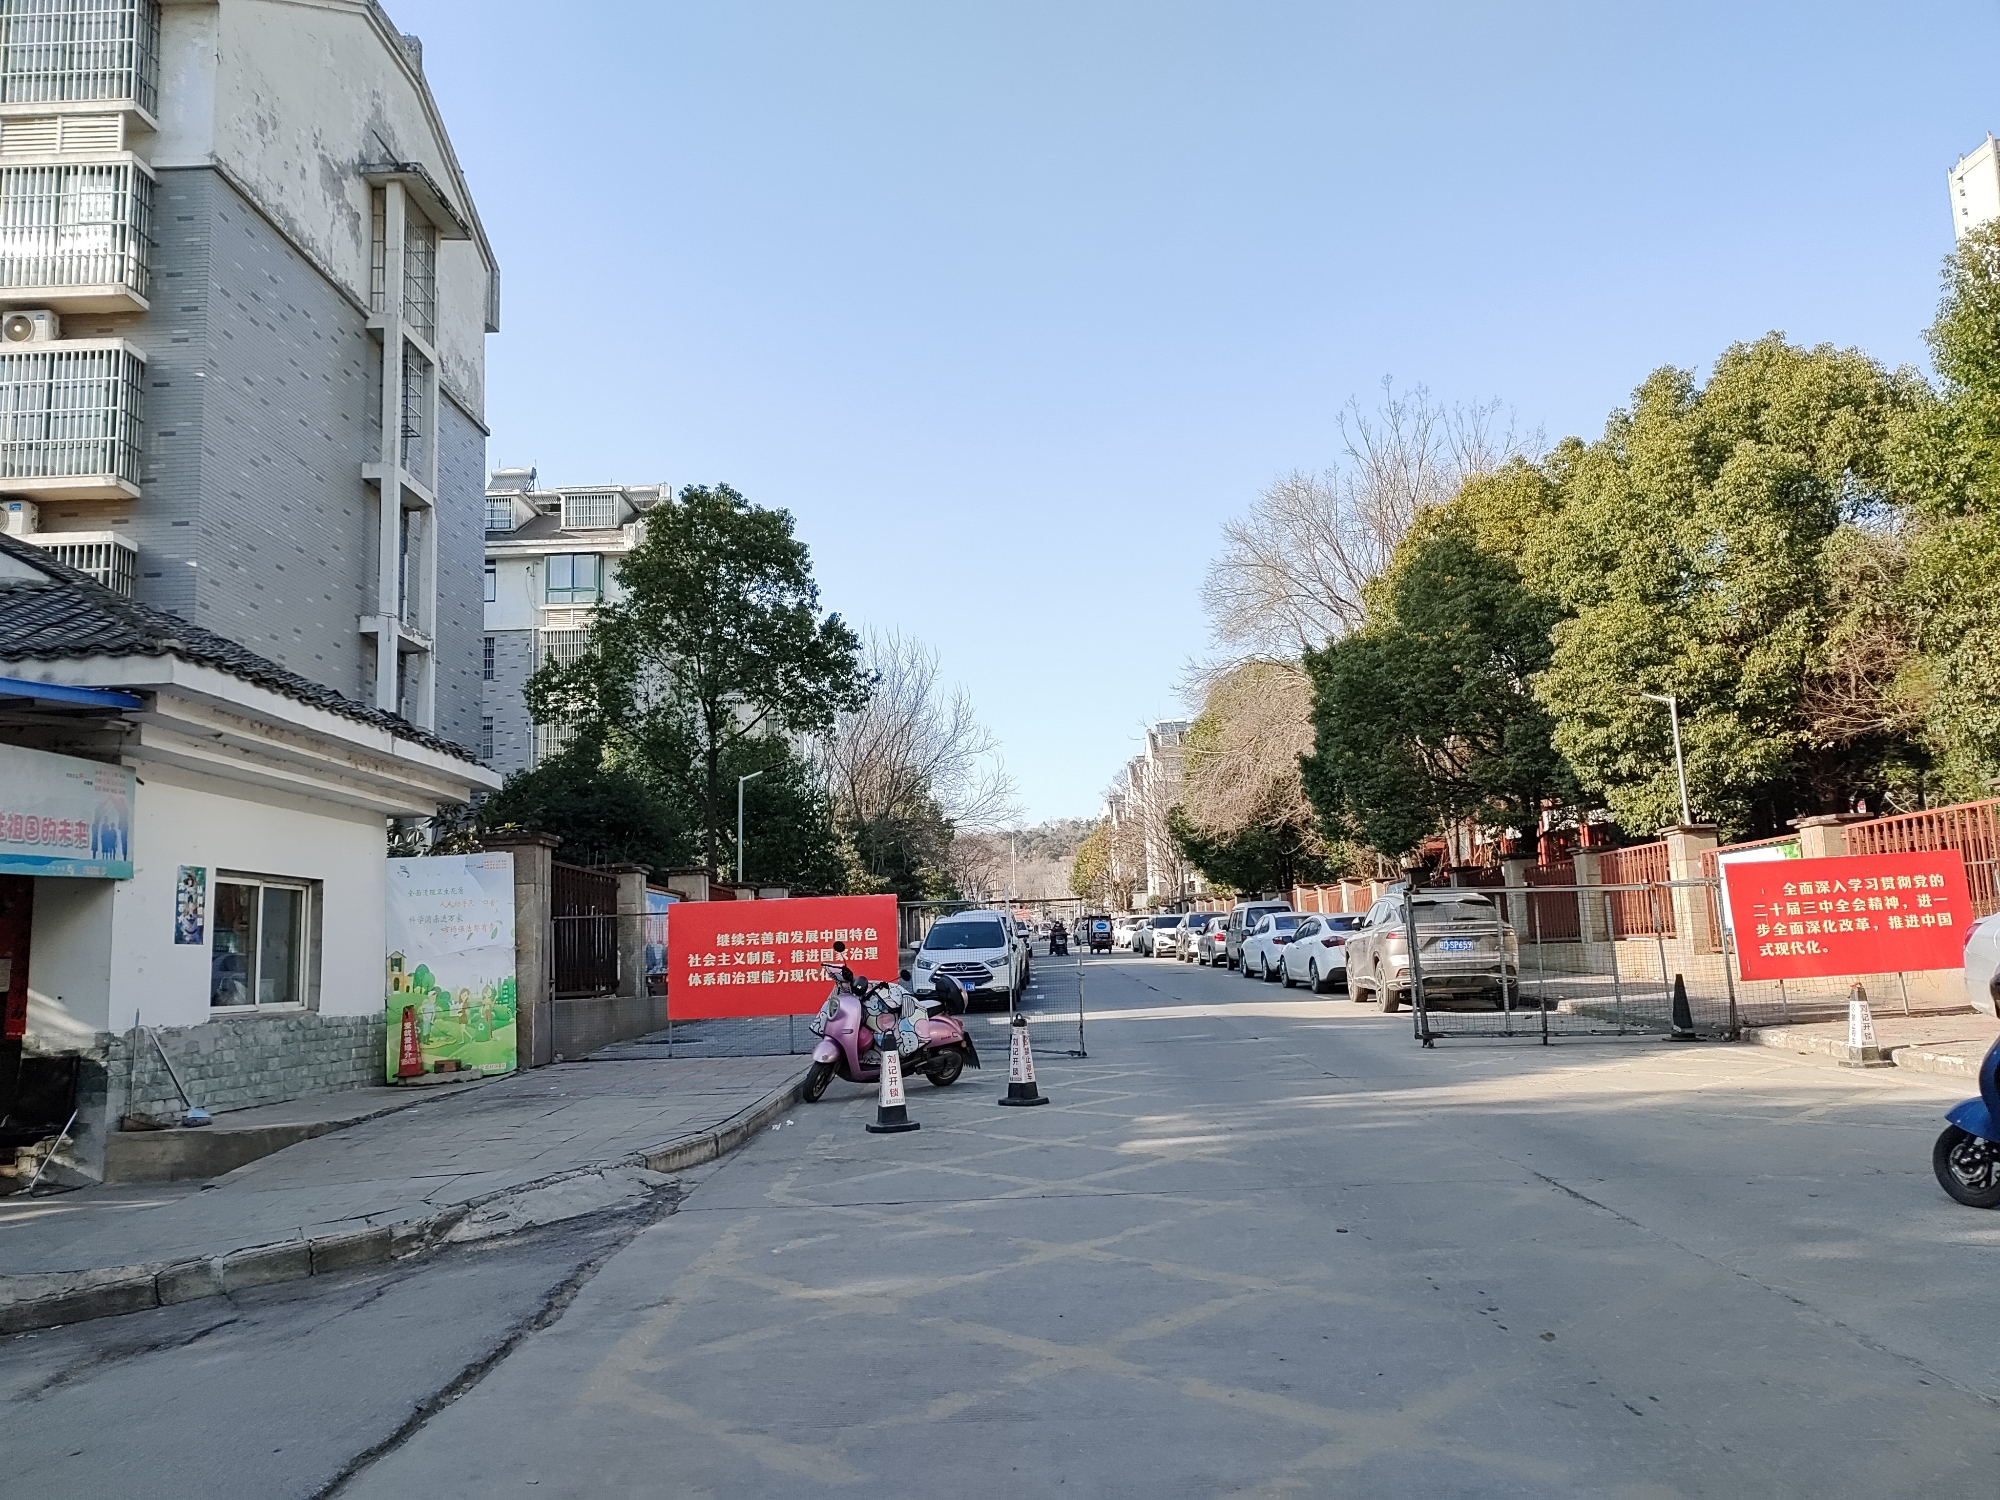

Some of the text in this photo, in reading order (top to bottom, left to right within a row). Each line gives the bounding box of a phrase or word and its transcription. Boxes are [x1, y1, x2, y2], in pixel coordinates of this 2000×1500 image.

[1783, 874, 1944, 896] 全面深入学习贯彻党的
[1753, 894, 1948, 917] 二十届三中全会精神，进一
[1756, 912, 1953, 938] 步全面深化改革，推进中国
[716, 928, 878, 947] 继续完善和发展中国特色
[1759, 940, 1829, 957] 式现代化。
[688, 947, 878, 968] 社会主义制度，推进国家治理
[887, 1054, 899, 1098] 刘记开锁
